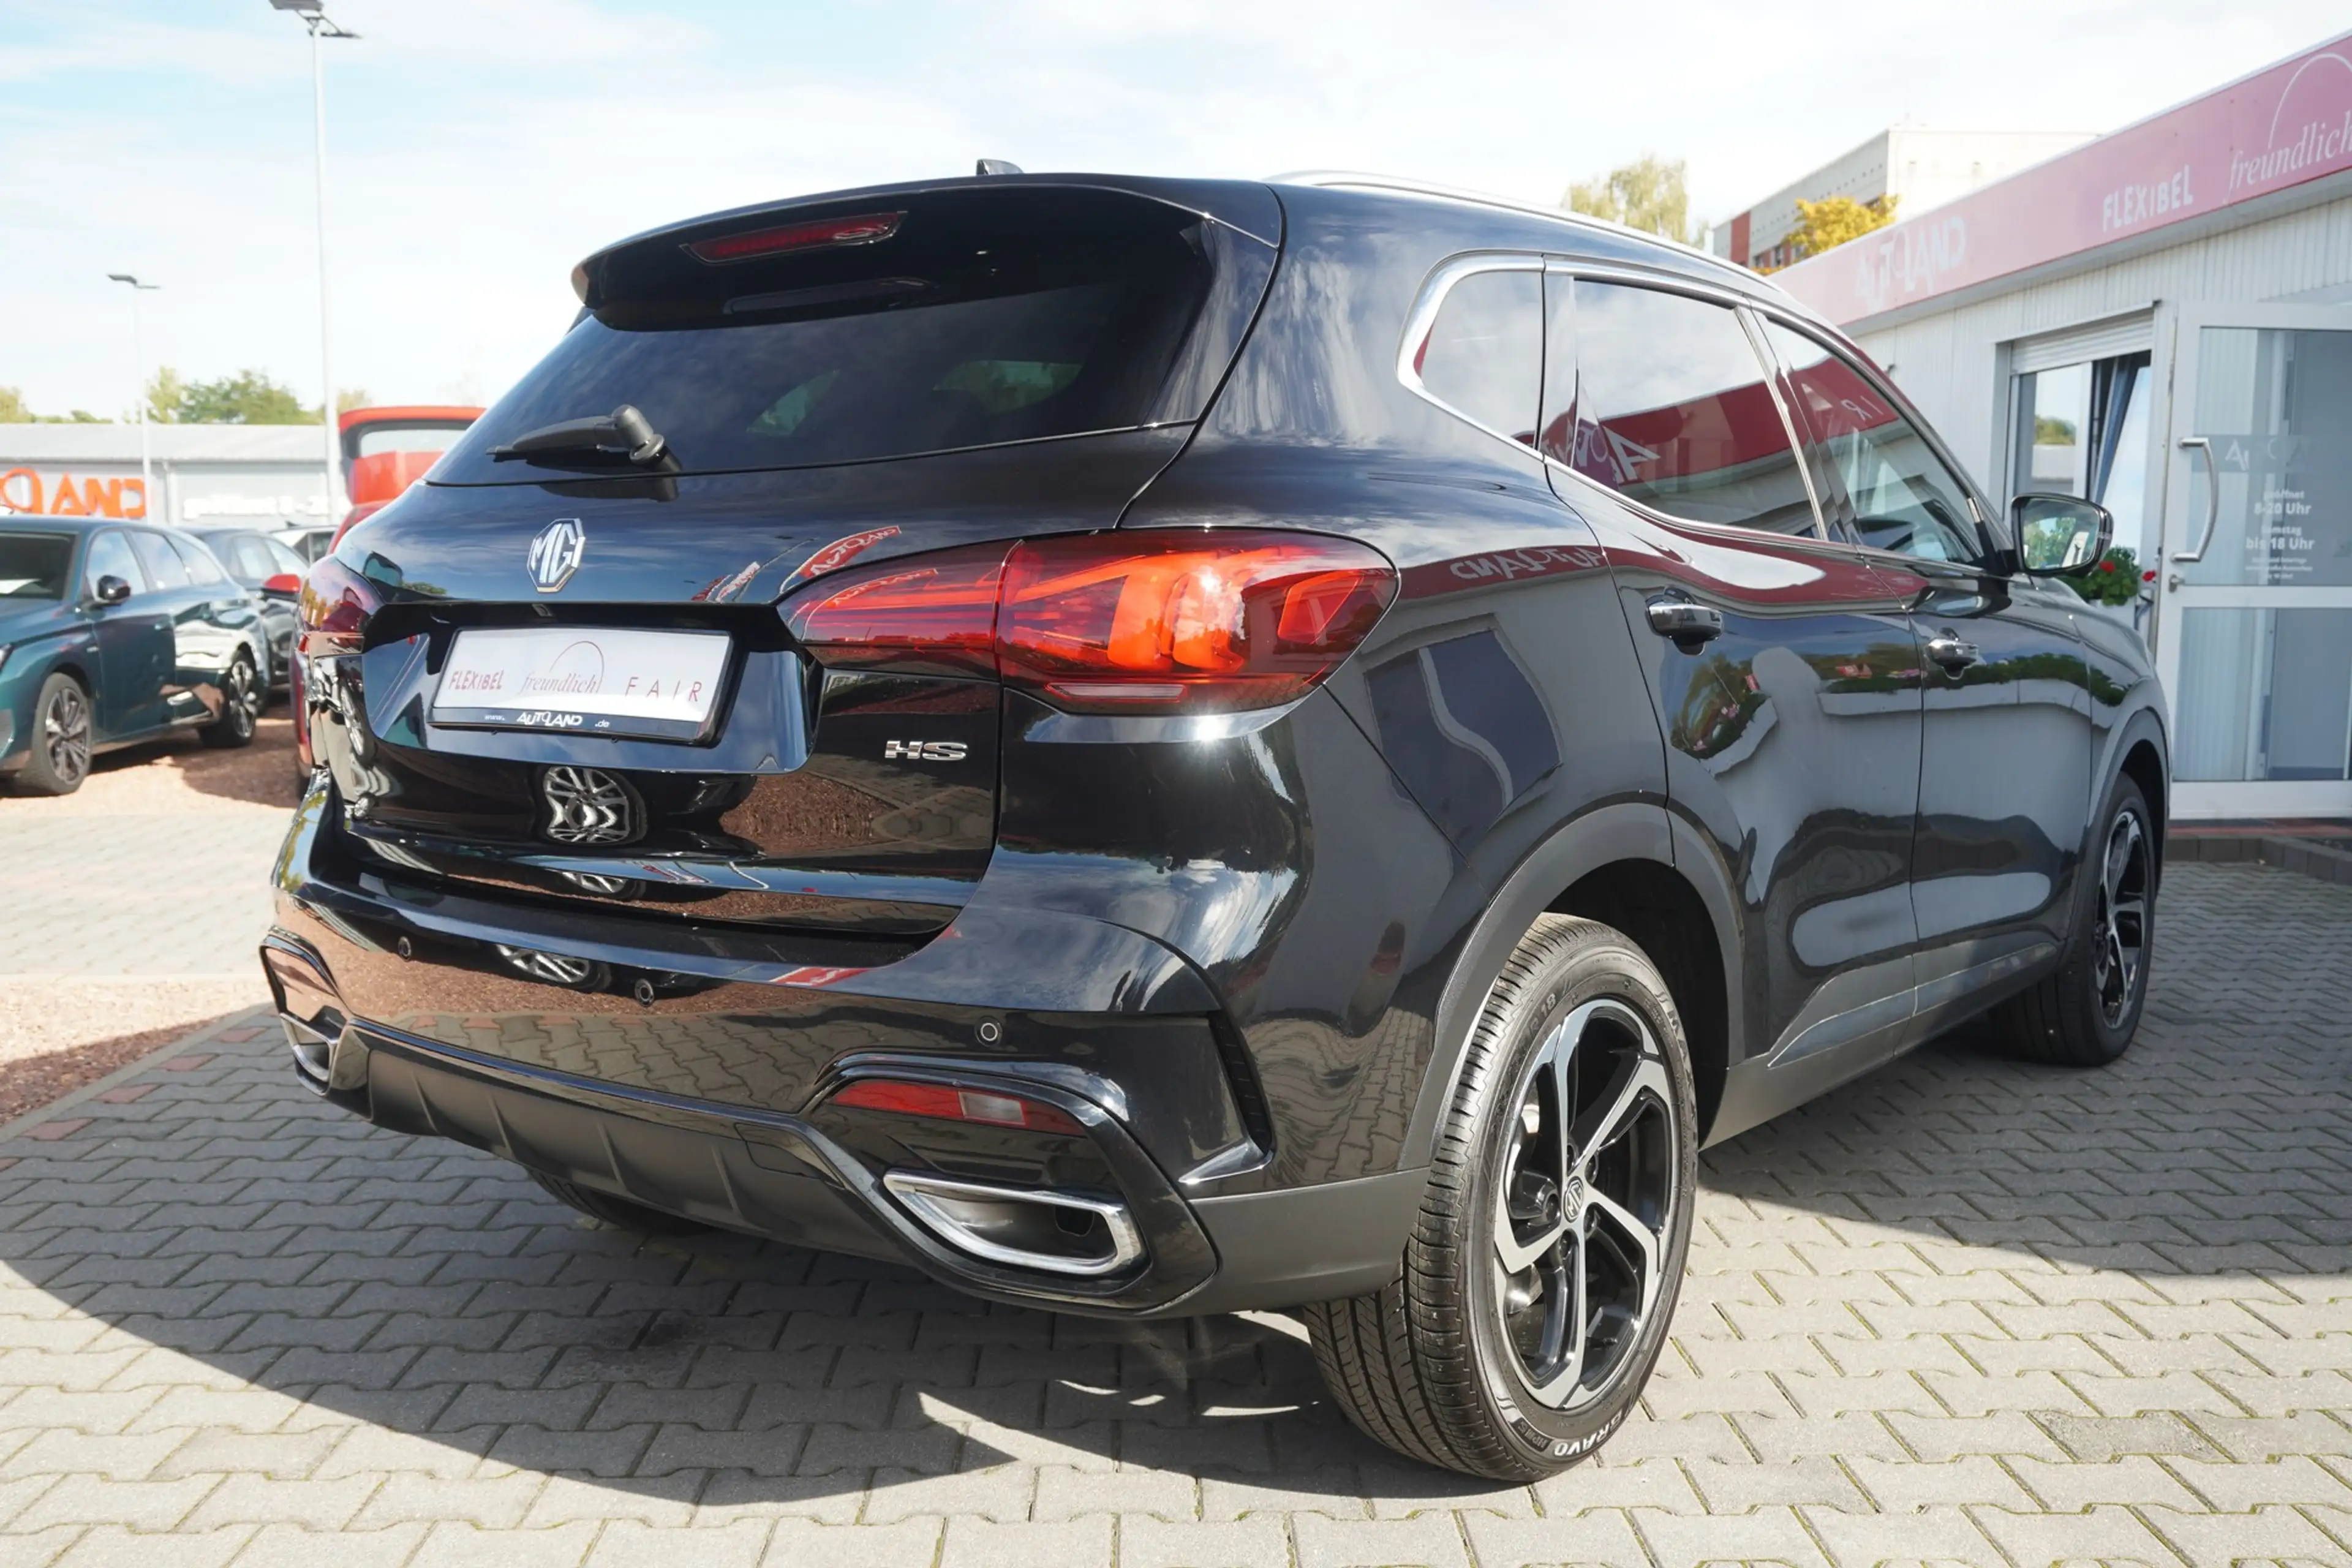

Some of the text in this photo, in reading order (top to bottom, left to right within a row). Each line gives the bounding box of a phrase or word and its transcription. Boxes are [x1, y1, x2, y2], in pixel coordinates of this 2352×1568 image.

[1855, 110, 2352, 314] AUTOLAND FLEXIBEL freundlich
[0, 467, 146, 519] OLAND
[2286, 502, 2312, 514] Uhr
[529, 521, 576, 584] MG
[2246, 537, 2315, 549] bis 18 Uhr
[448, 669, 503, 690] FLEXIBEL
[519, 671, 598, 695] freundlich
[516, 711, 583, 728] AUTOLAND
[594, 719, 610, 728] .de
[884, 741, 968, 761] HS
[1553, 1409, 1623, 1457] BRAVO
